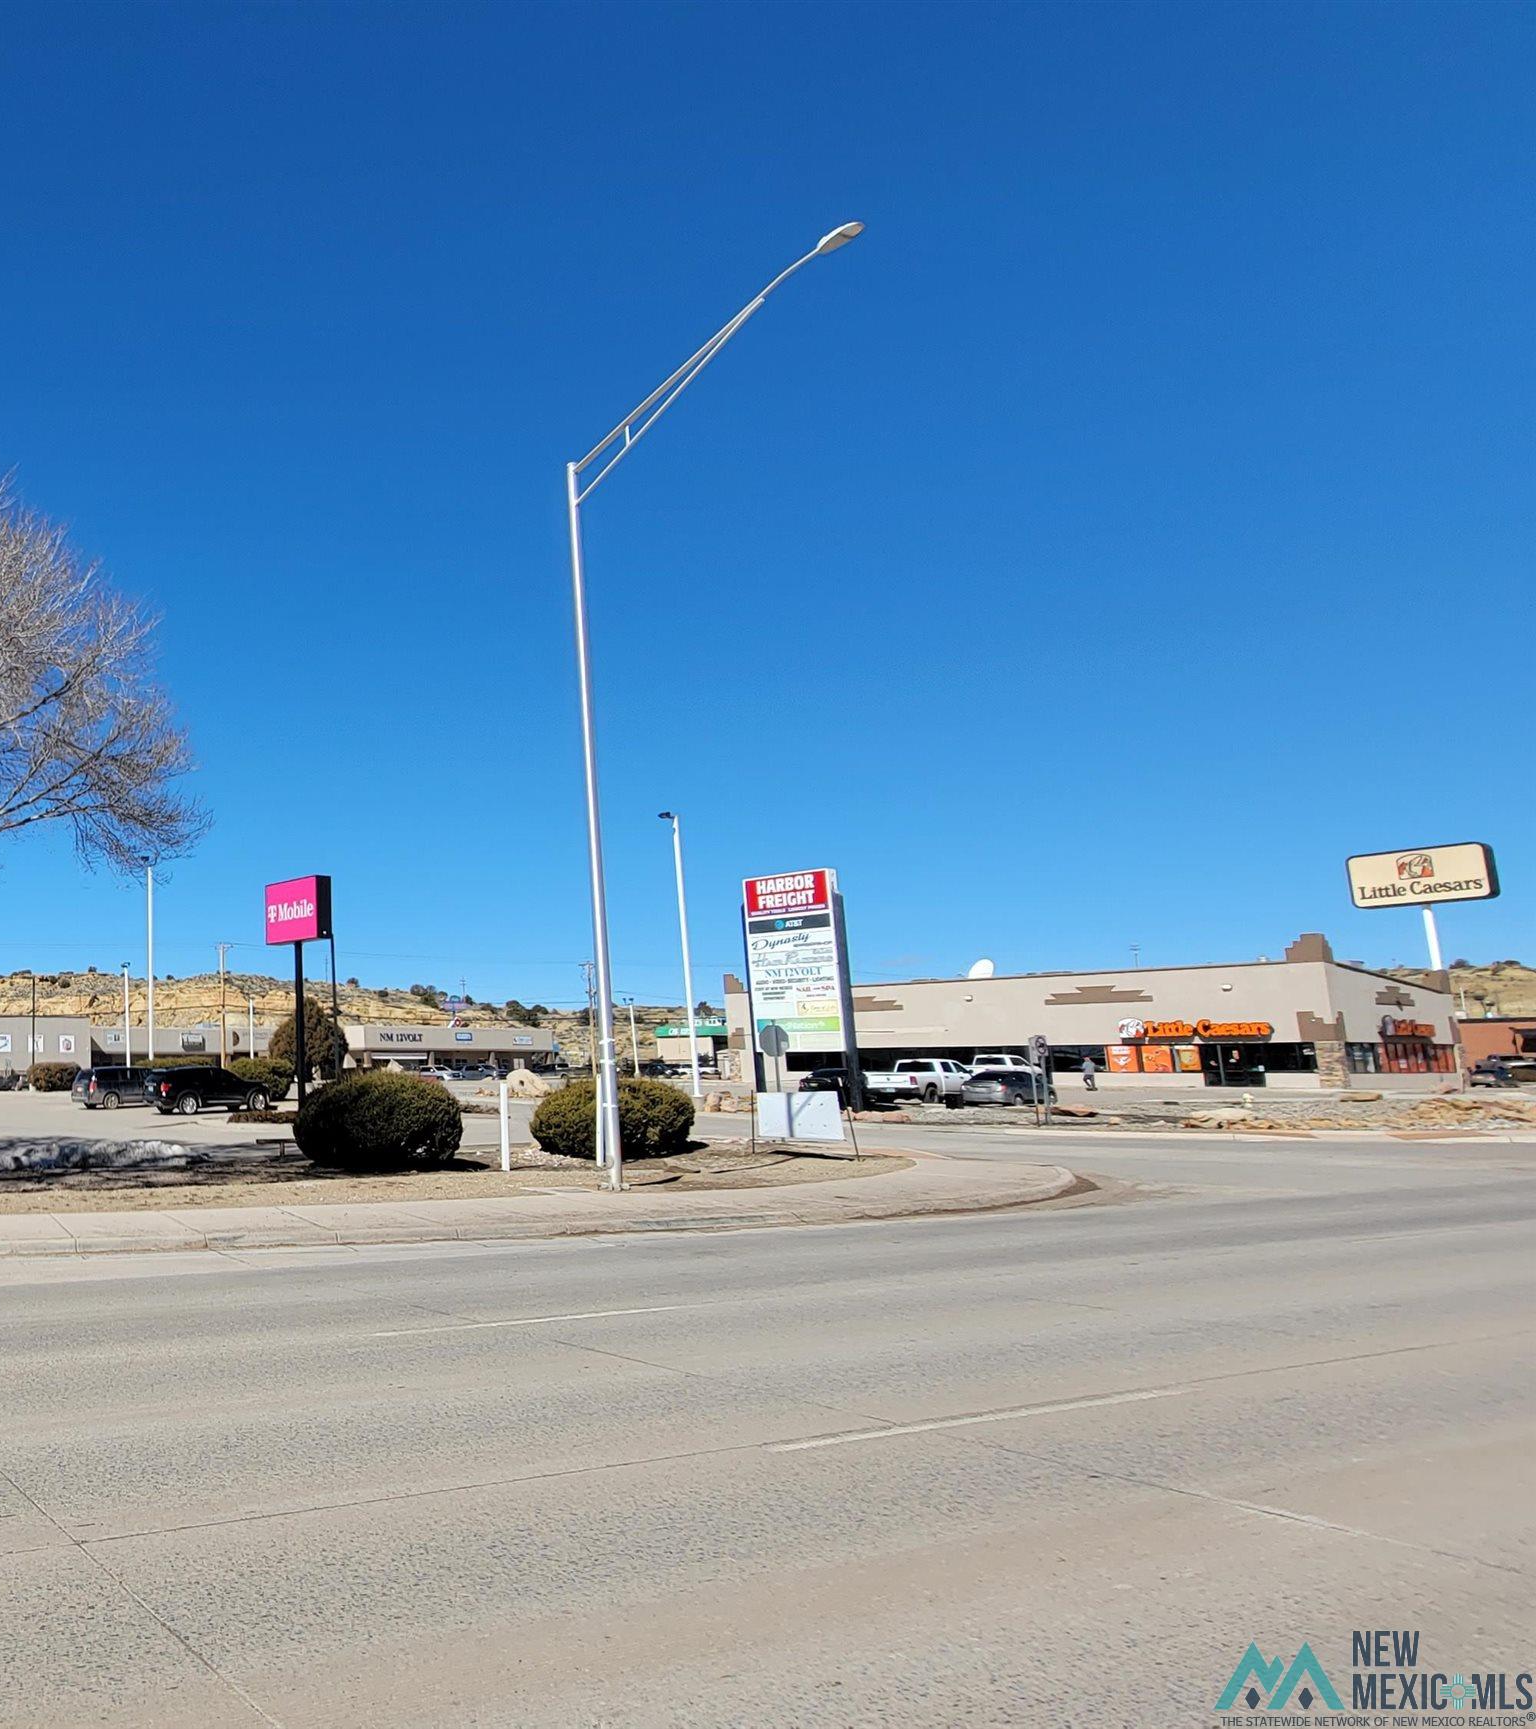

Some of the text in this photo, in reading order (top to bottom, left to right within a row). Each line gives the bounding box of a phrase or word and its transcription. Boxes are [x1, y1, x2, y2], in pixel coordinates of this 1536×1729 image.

[756, 874, 815, 895] HARBOR
[1358, 878, 1483, 900] Little Caesars
[758, 889, 815, 909] FREIGHT
[278, 898, 314, 922] Mobile
[785, 919, 804, 928] AT&T
[751, 932, 811, 950] Dynasty
[765, 968, 781, 978] NM
[379, 1032, 394, 1042] NM
[1143, 1018, 1273, 1038] Little Caesars
